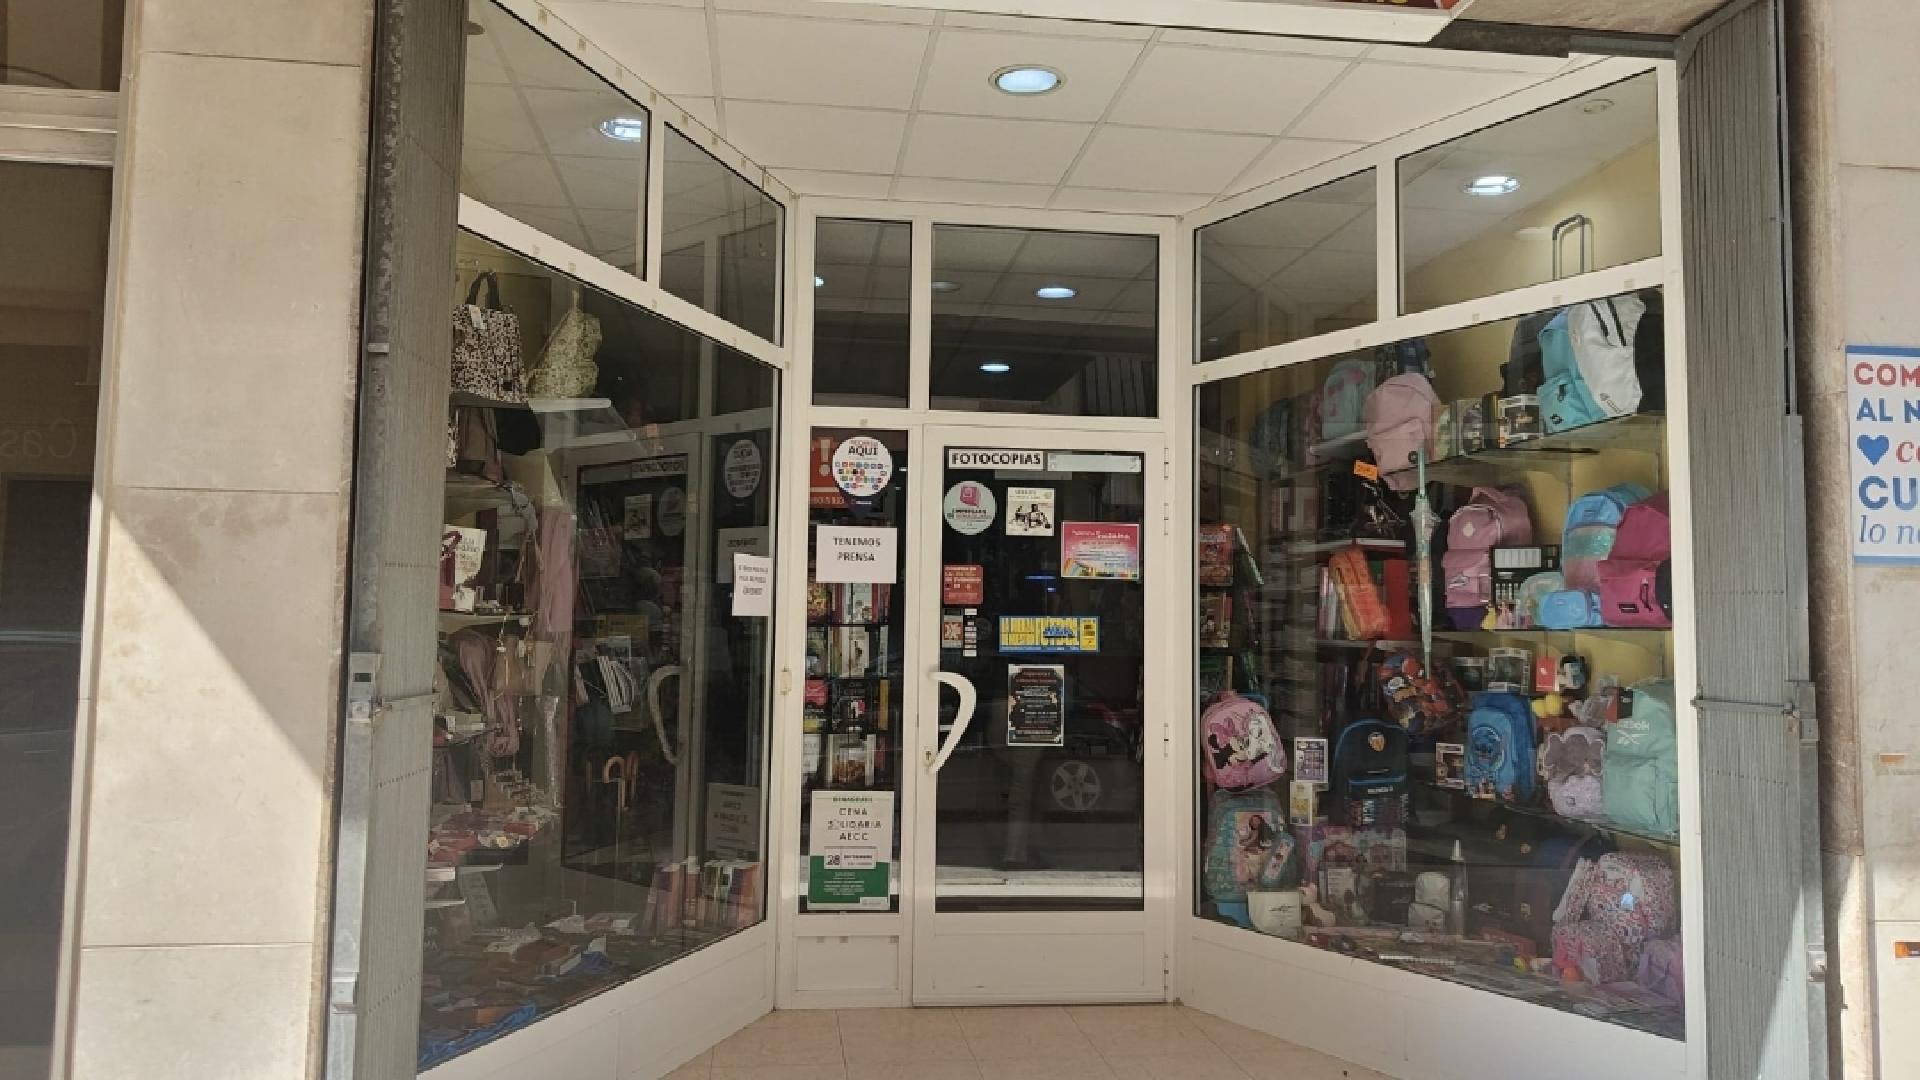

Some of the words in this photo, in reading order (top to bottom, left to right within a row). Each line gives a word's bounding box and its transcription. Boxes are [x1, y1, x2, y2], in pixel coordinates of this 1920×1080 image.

[1856, 397, 1894, 422] AL
[951, 453, 1041, 465] FOTOCOPIAS
[1859, 475, 1918, 510] CU
[1859, 514, 1886, 543] lo
[833, 536, 881, 547] TENEMOS
[837, 551, 876, 561] PRENSA
